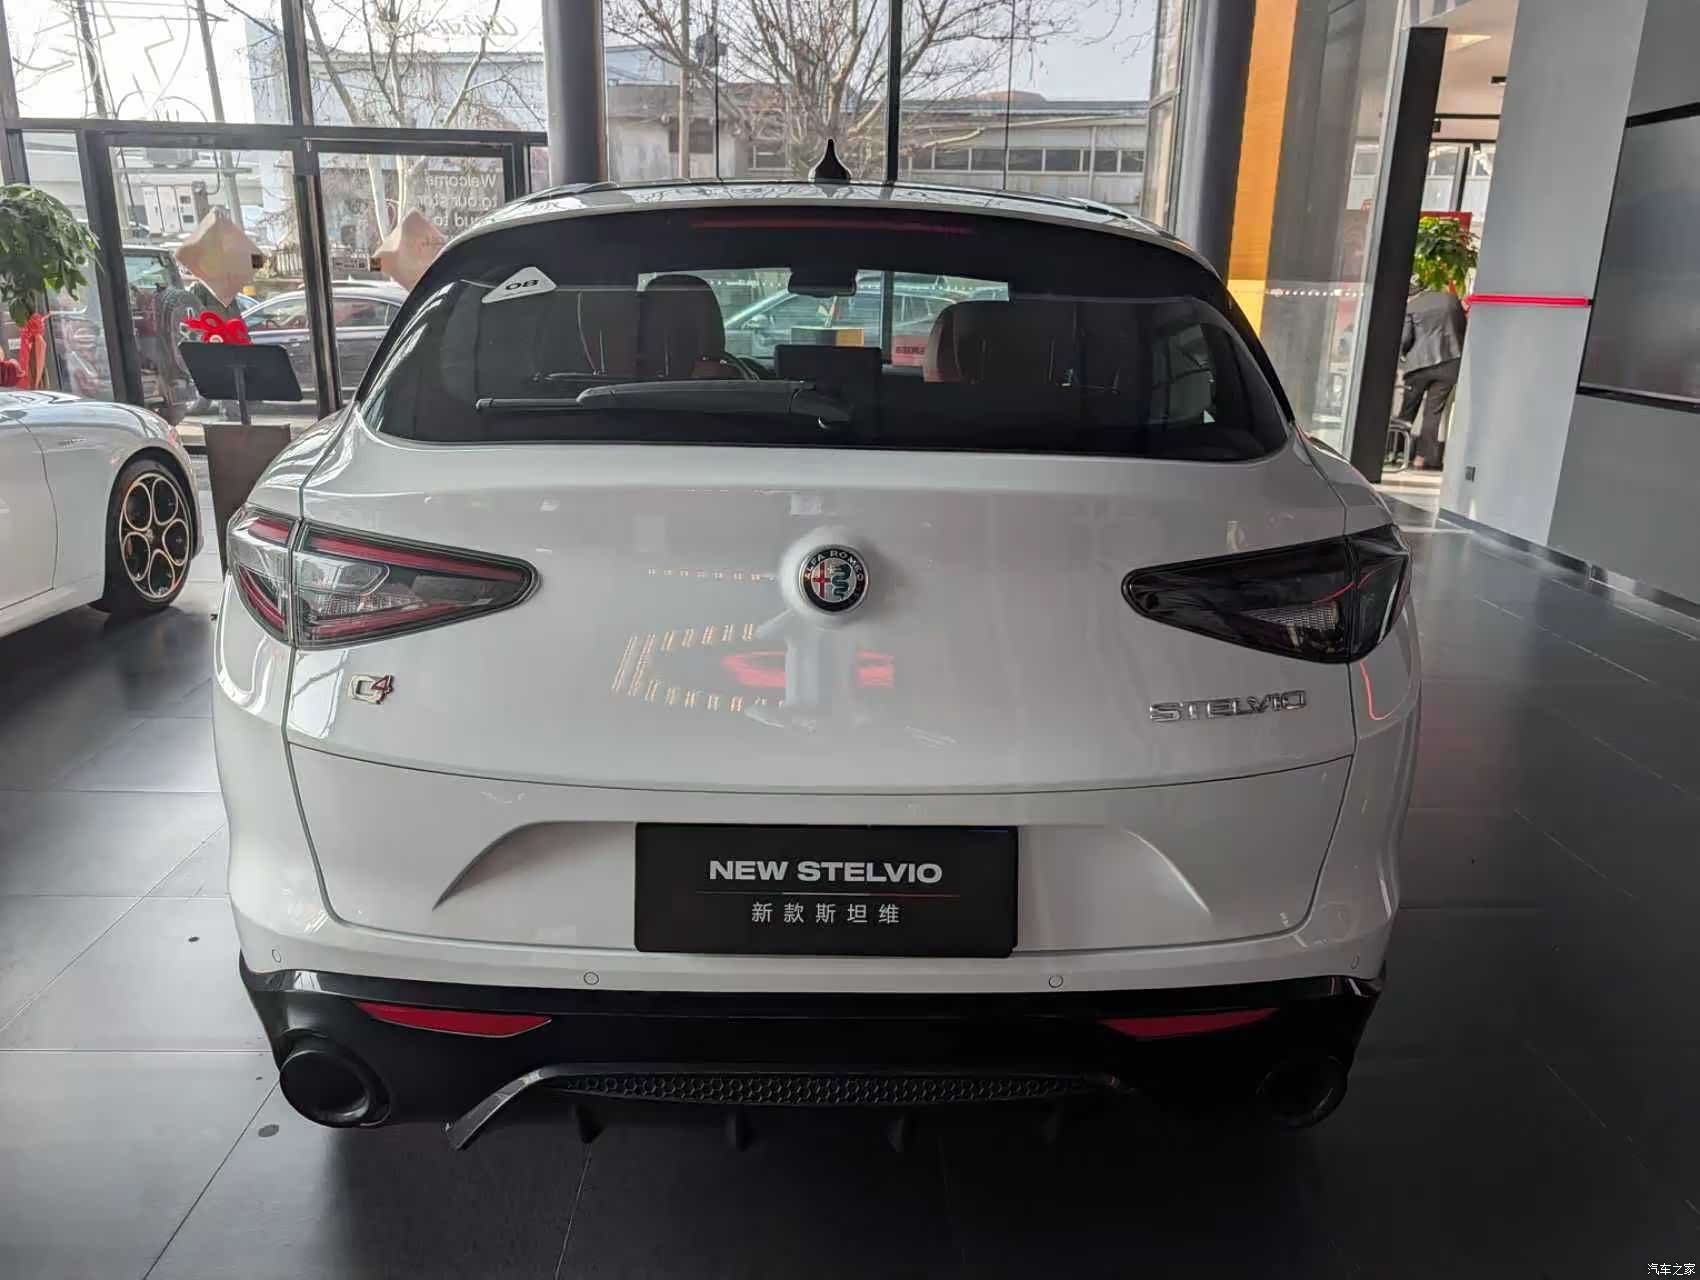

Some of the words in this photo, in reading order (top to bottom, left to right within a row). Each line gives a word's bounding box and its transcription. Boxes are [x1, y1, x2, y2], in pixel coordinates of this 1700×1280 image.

[804, 553, 825, 580] ALFA
[829, 549, 864, 582] ROMEO
[350, 672, 394, 705] Q4
[1149, 689, 1307, 723] STELVIO
[708, 860, 789, 881] NEW
[796, 860, 943, 884] STELVIO
[751, 901, 900, 925] 新款斯坦维
